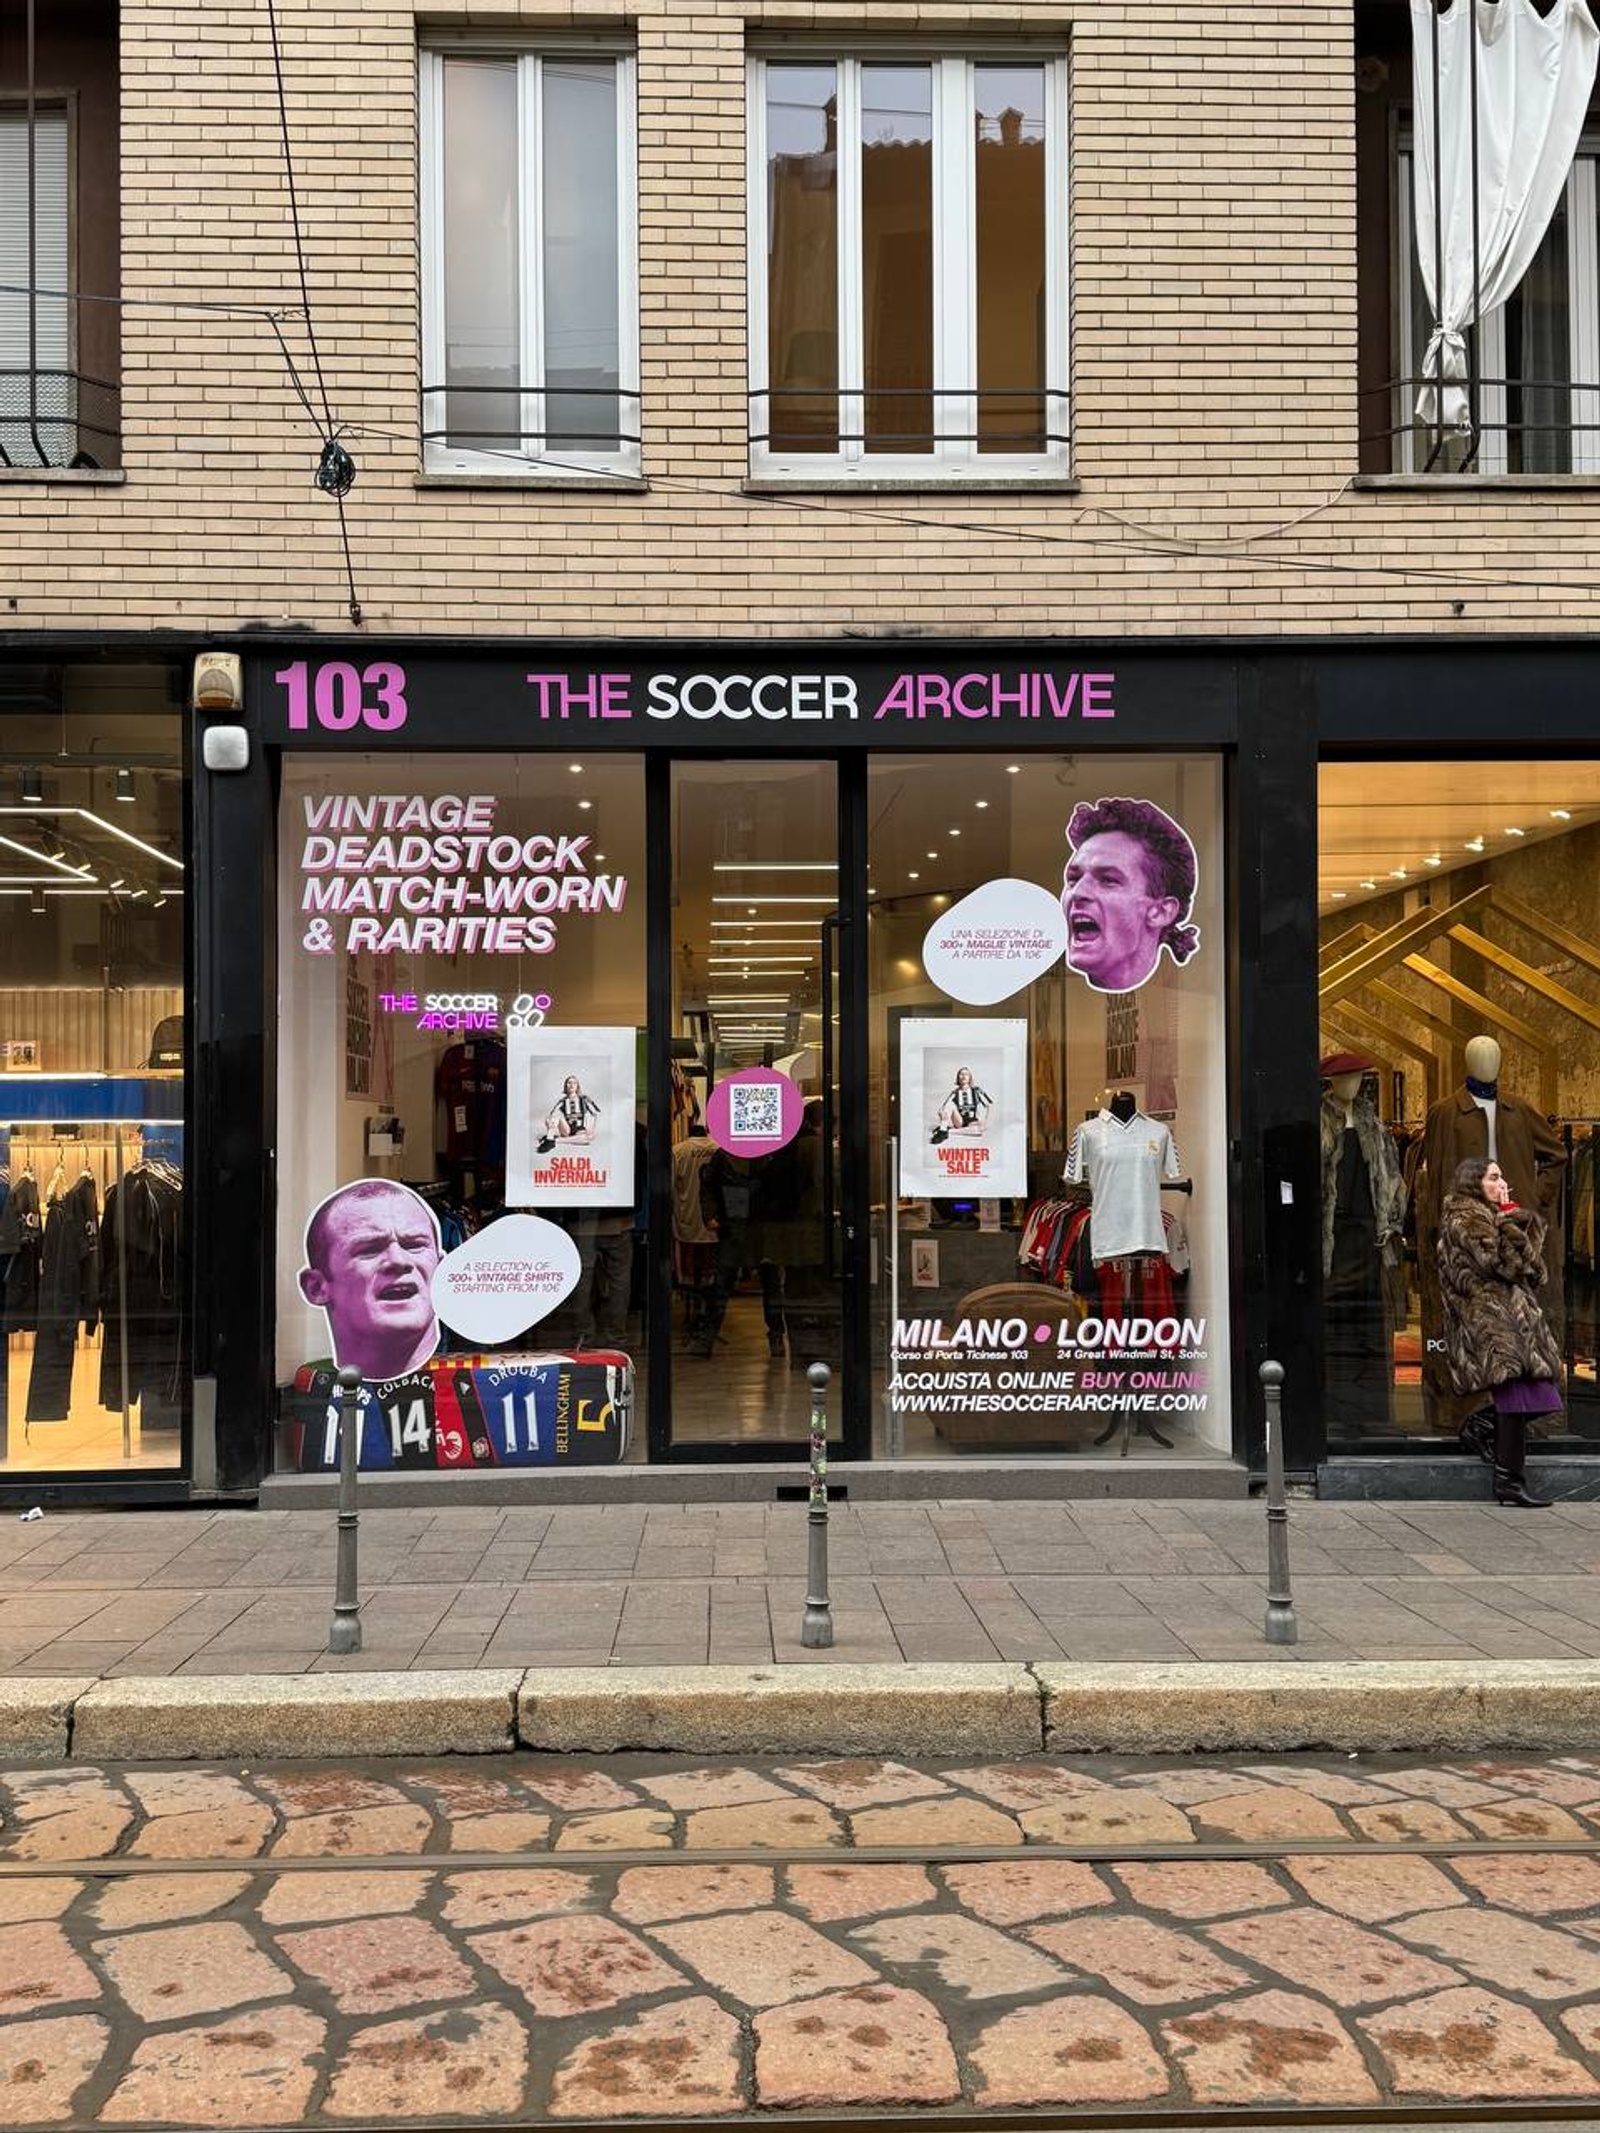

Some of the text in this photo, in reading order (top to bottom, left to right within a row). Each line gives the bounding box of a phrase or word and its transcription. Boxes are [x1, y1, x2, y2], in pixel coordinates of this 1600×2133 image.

[275, 661, 408, 731] 103
[526, 673, 1116, 720] THE SOCCER ARCHIVE
[302, 795, 496, 832] VINTAGE
[301, 836, 591, 873] DEADSTOCK
[302, 875, 628, 913] MATCH-WORN
[302, 916, 558, 955] & RARITIES
[951, 929, 1043, 939] UNA SELEZIONE DI
[940, 940, 1053, 949] 300+ MAGLIE VINTAGE
[951, 950, 1042, 960] A PARTIRE DA 10€
[379, 993, 498, 1013] THE SOCCER
[416, 1013, 499, 1030] ARCHIVE
[938, 1148, 990, 1161] WINTER
[550, 1157, 591, 1171] SALDI
[947, 1161, 981, 1174] SALE
[534, 1170, 607, 1183] INVERNALI
[463, 1261, 551, 1272] A SELECTION OF
[448, 1272, 564, 1283] 300+ VINTAGE SHIRTS
[453, 1283, 561, 1293] STARTING FROM 10€
[891, 1318, 1207, 1348] MILANO LONDON
[890, 1350, 1029, 1360] Corso di Porta Ticinese 103
[1057, 1350, 1208, 1361] 24 Great Windmill St, Soho
[488, 1363, 548, 1387] DROGBA
[889, 1372, 1208, 1391] ACQUISTA ONLINE BUY ONLINE
[892, 1394, 1208, 1412] WWW.THESOCCERARCHIVE.COM
[501, 1391, 540, 1453] 11
[556, 1373, 571, 1453] BELLINGHAM
[388, 1398, 432, 1457] 14
